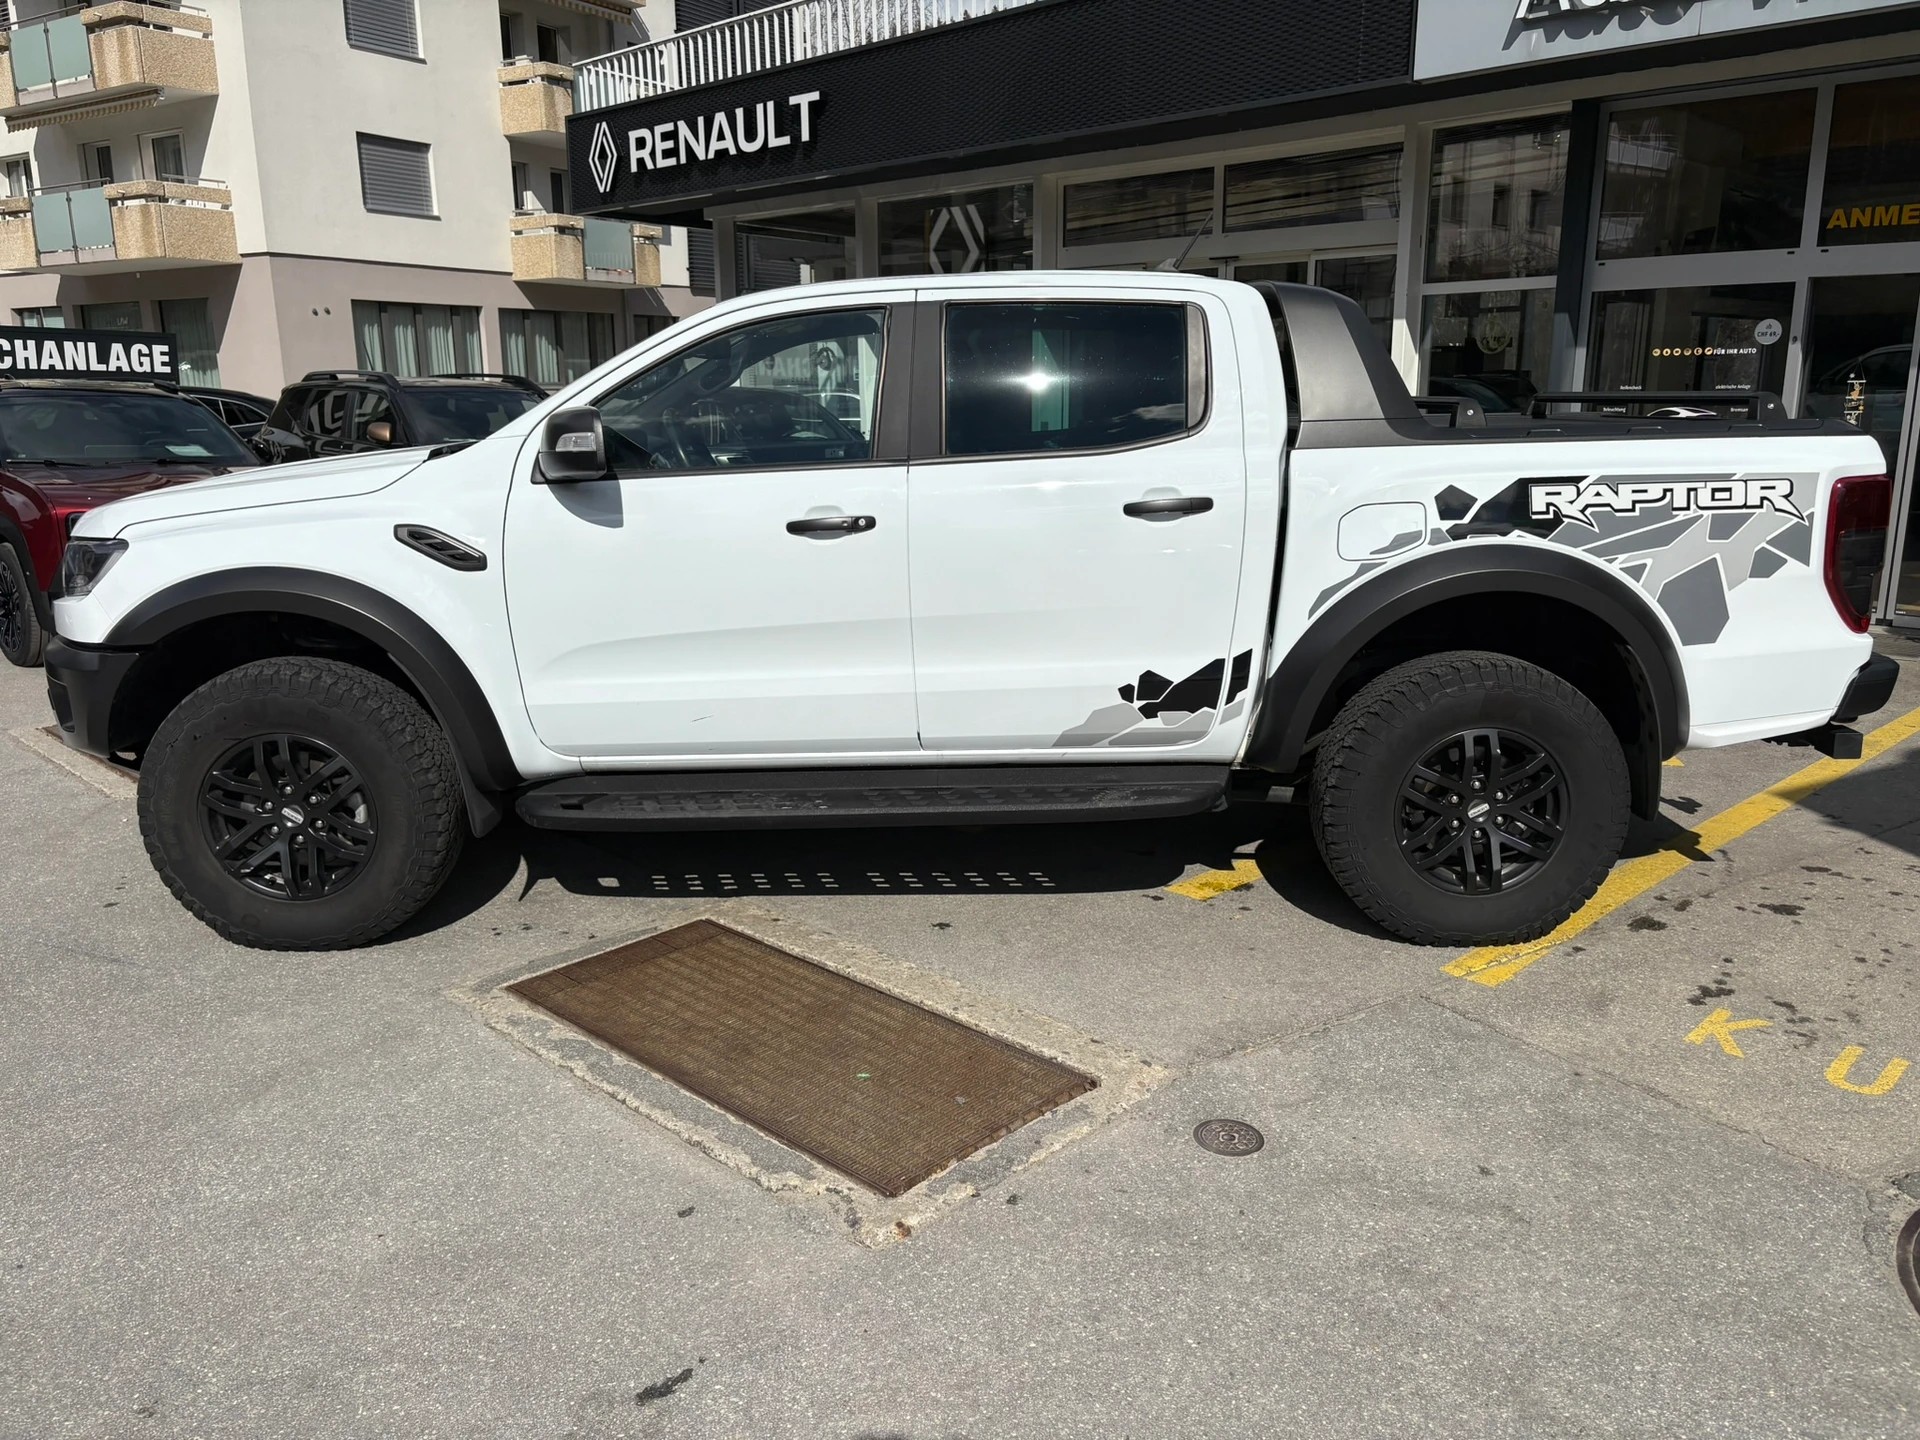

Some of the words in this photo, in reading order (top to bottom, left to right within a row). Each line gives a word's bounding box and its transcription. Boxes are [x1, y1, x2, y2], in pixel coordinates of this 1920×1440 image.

[628, 91, 820, 173] RENAULT
[1826, 203, 1920, 229] ANME
[1713, 346, 1726, 355] FÜR
[1529, 479, 1808, 533] RAPTOR
